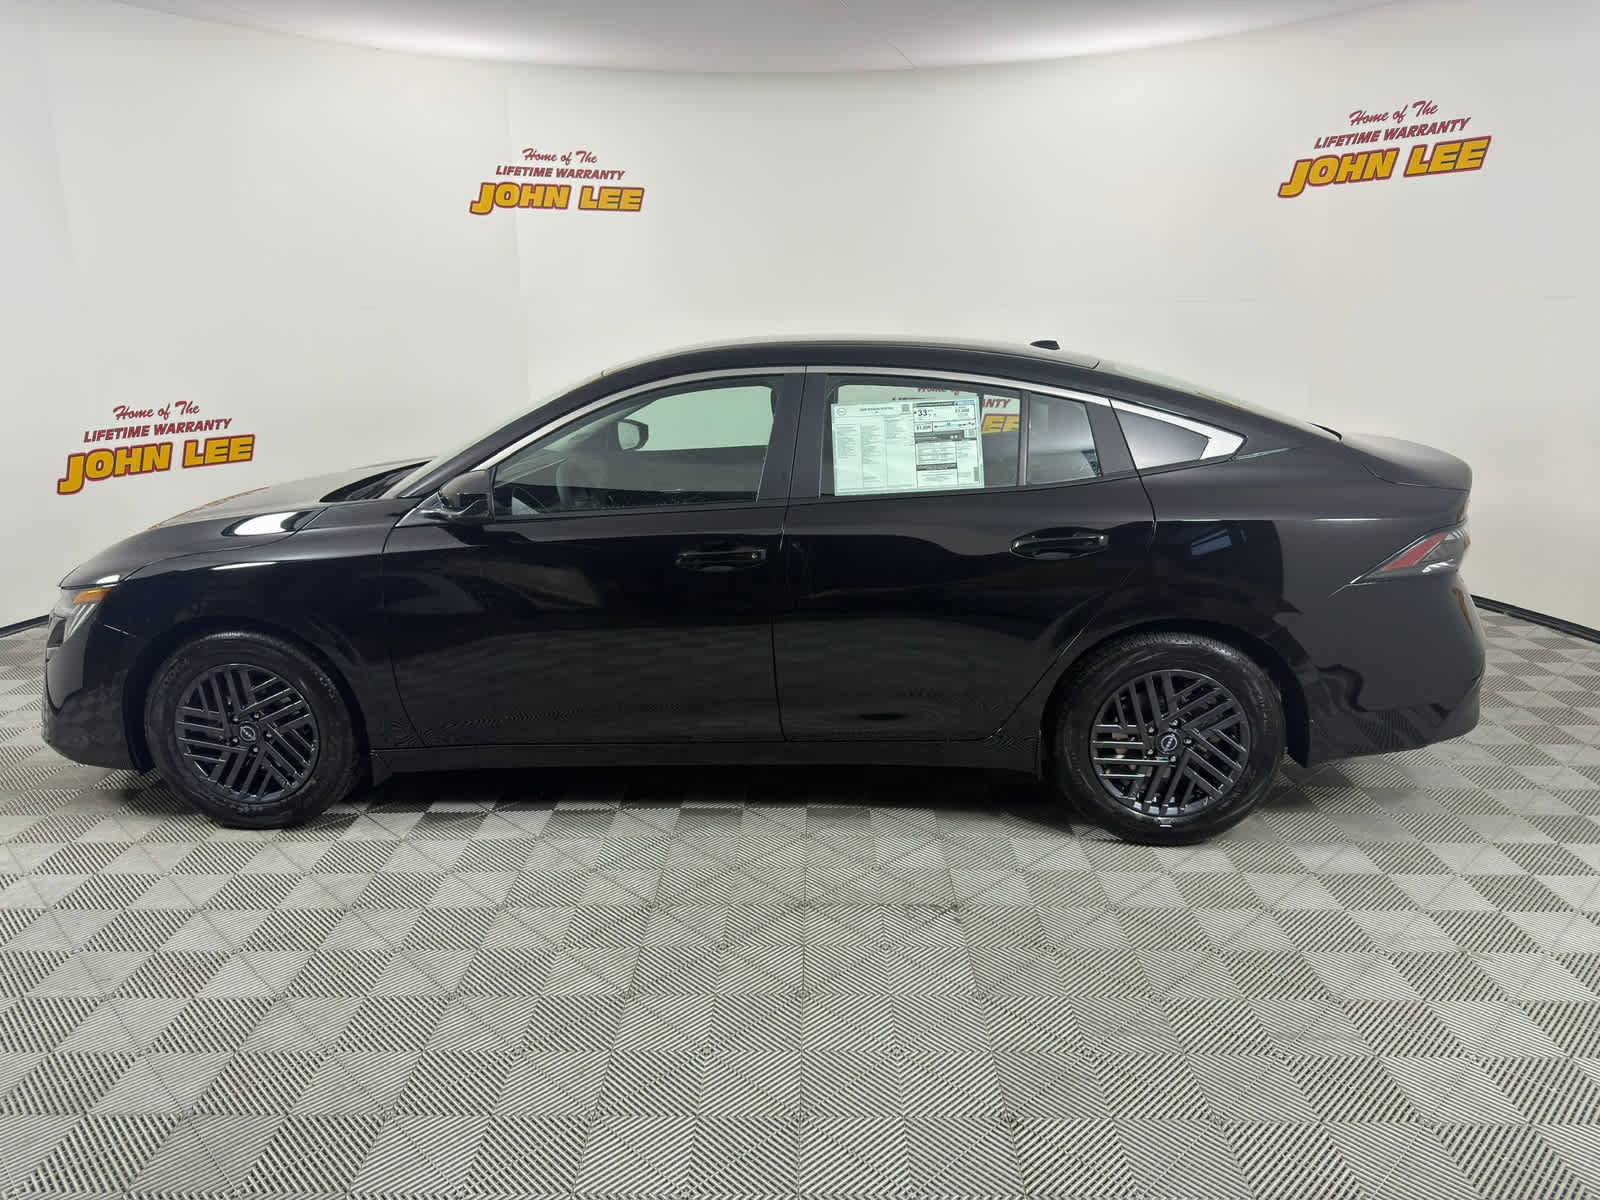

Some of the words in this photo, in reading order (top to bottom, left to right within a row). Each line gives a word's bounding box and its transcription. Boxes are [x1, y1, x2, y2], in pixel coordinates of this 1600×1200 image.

[1349, 110, 1389, 126] Home
[1392, 105, 1408, 124] of
[1412, 100, 1438, 117] The
[1314, 130, 1381, 149] LIFETIME
[1384, 117, 1471, 140] WARRANTY
[522, 148, 557, 161] Home
[561, 152, 573, 165] of
[576, 151, 597, 163] The
[1278, 147, 1400, 198] JOHN
[1403, 135, 1492, 178] LEE
[496, 166, 553, 178] LIFETIME
[556, 168, 625, 180] WARRANTY
[469, 182, 571, 215] JOHN
[578, 185, 645, 212] LEE
[113, 405, 154, 420] Home
[158, 404, 170, 420] of
[175, 400, 200, 415] The
[84, 425, 150, 443] LIFETIME
[154, 418, 232, 435] WARRANTY
[57, 441, 173, 495] JOHN
[182, 434, 255, 468] LEE
